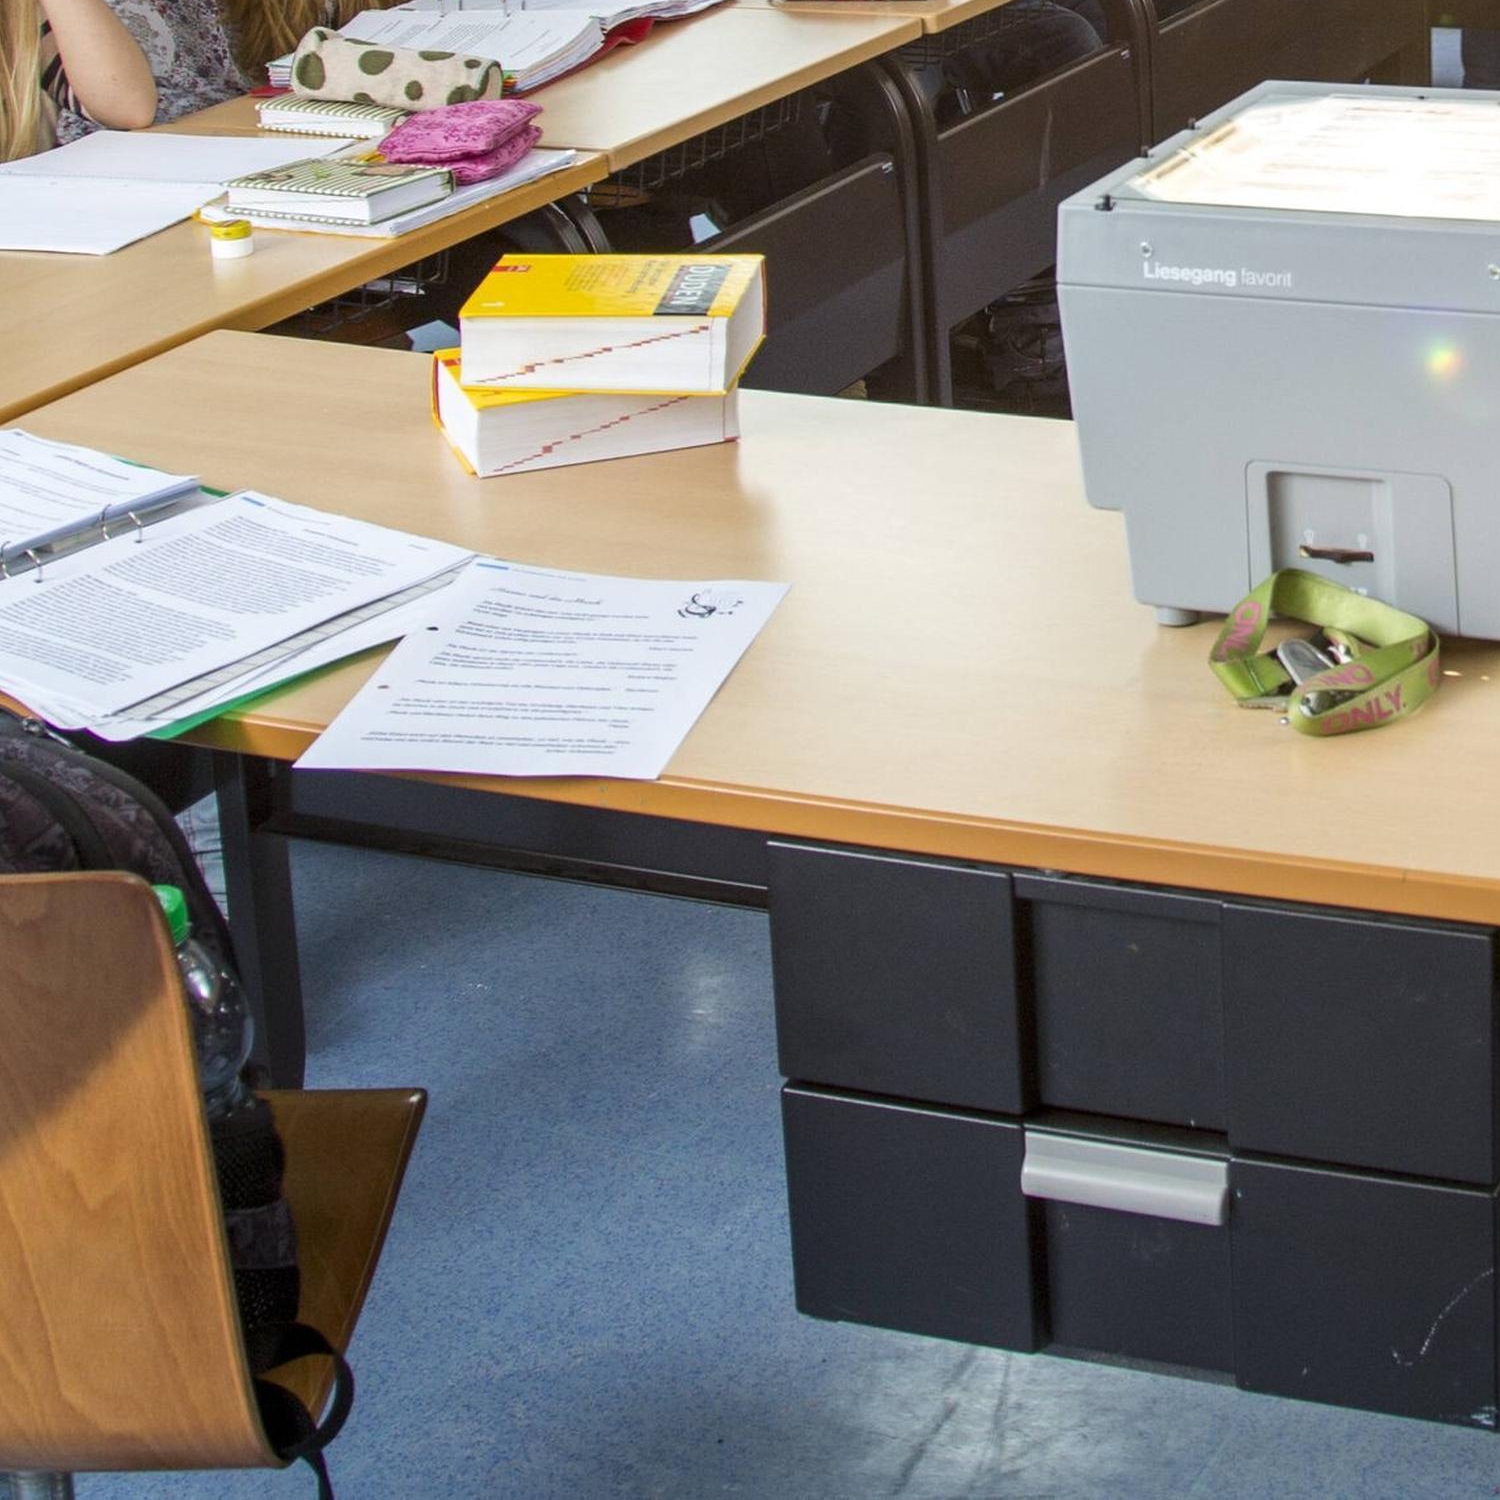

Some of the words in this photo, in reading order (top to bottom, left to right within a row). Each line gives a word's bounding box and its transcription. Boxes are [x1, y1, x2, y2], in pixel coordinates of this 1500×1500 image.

[670, 266, 716, 305] DUDEN
[1143, 261, 1236, 287] Liesegang
[1241, 268, 1292, 287] favorit
